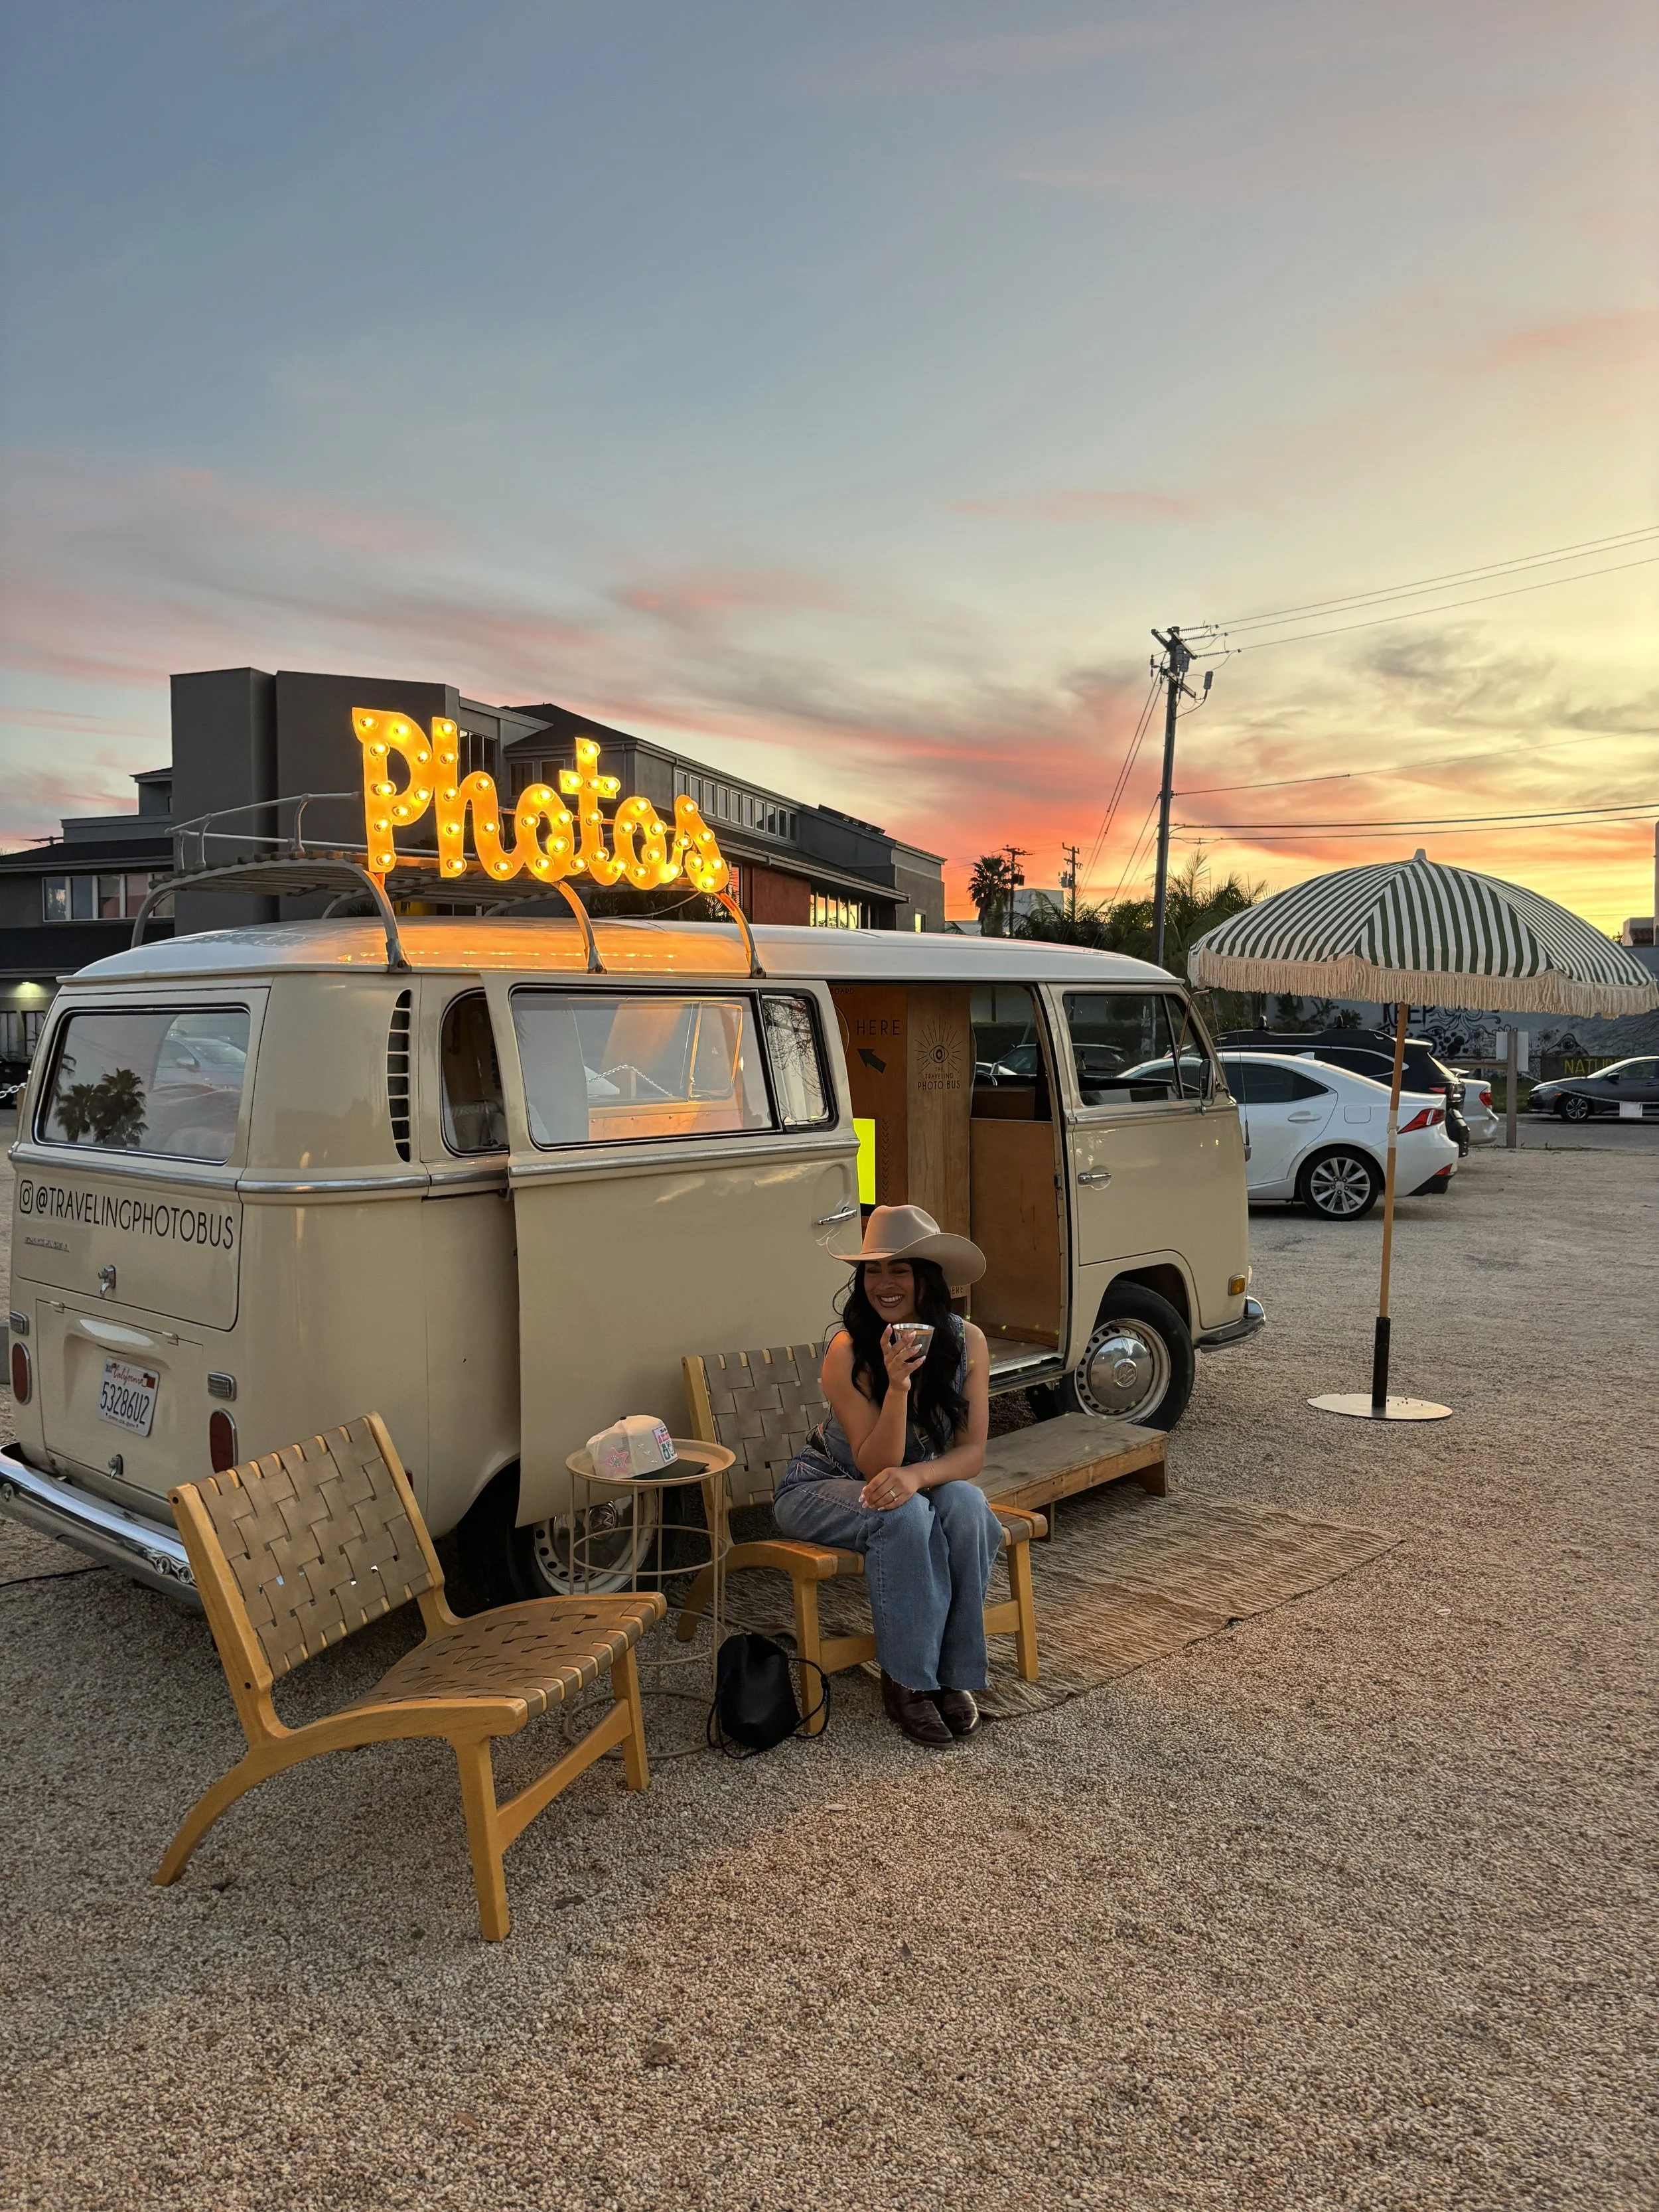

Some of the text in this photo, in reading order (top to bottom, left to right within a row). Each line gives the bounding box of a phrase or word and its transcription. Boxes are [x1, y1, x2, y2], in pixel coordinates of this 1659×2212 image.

[352, 707, 730, 893] Photos
[856, 1019, 901, 1036] HERE
[1563, 1059, 1623, 1074] NATU
[918, 1080, 960, 1090] PHOTO BUS
[36, 1186, 234, 1250] @TRAVELINGPHOTOBUS
[100, 1380, 150, 1425] 53286U2
